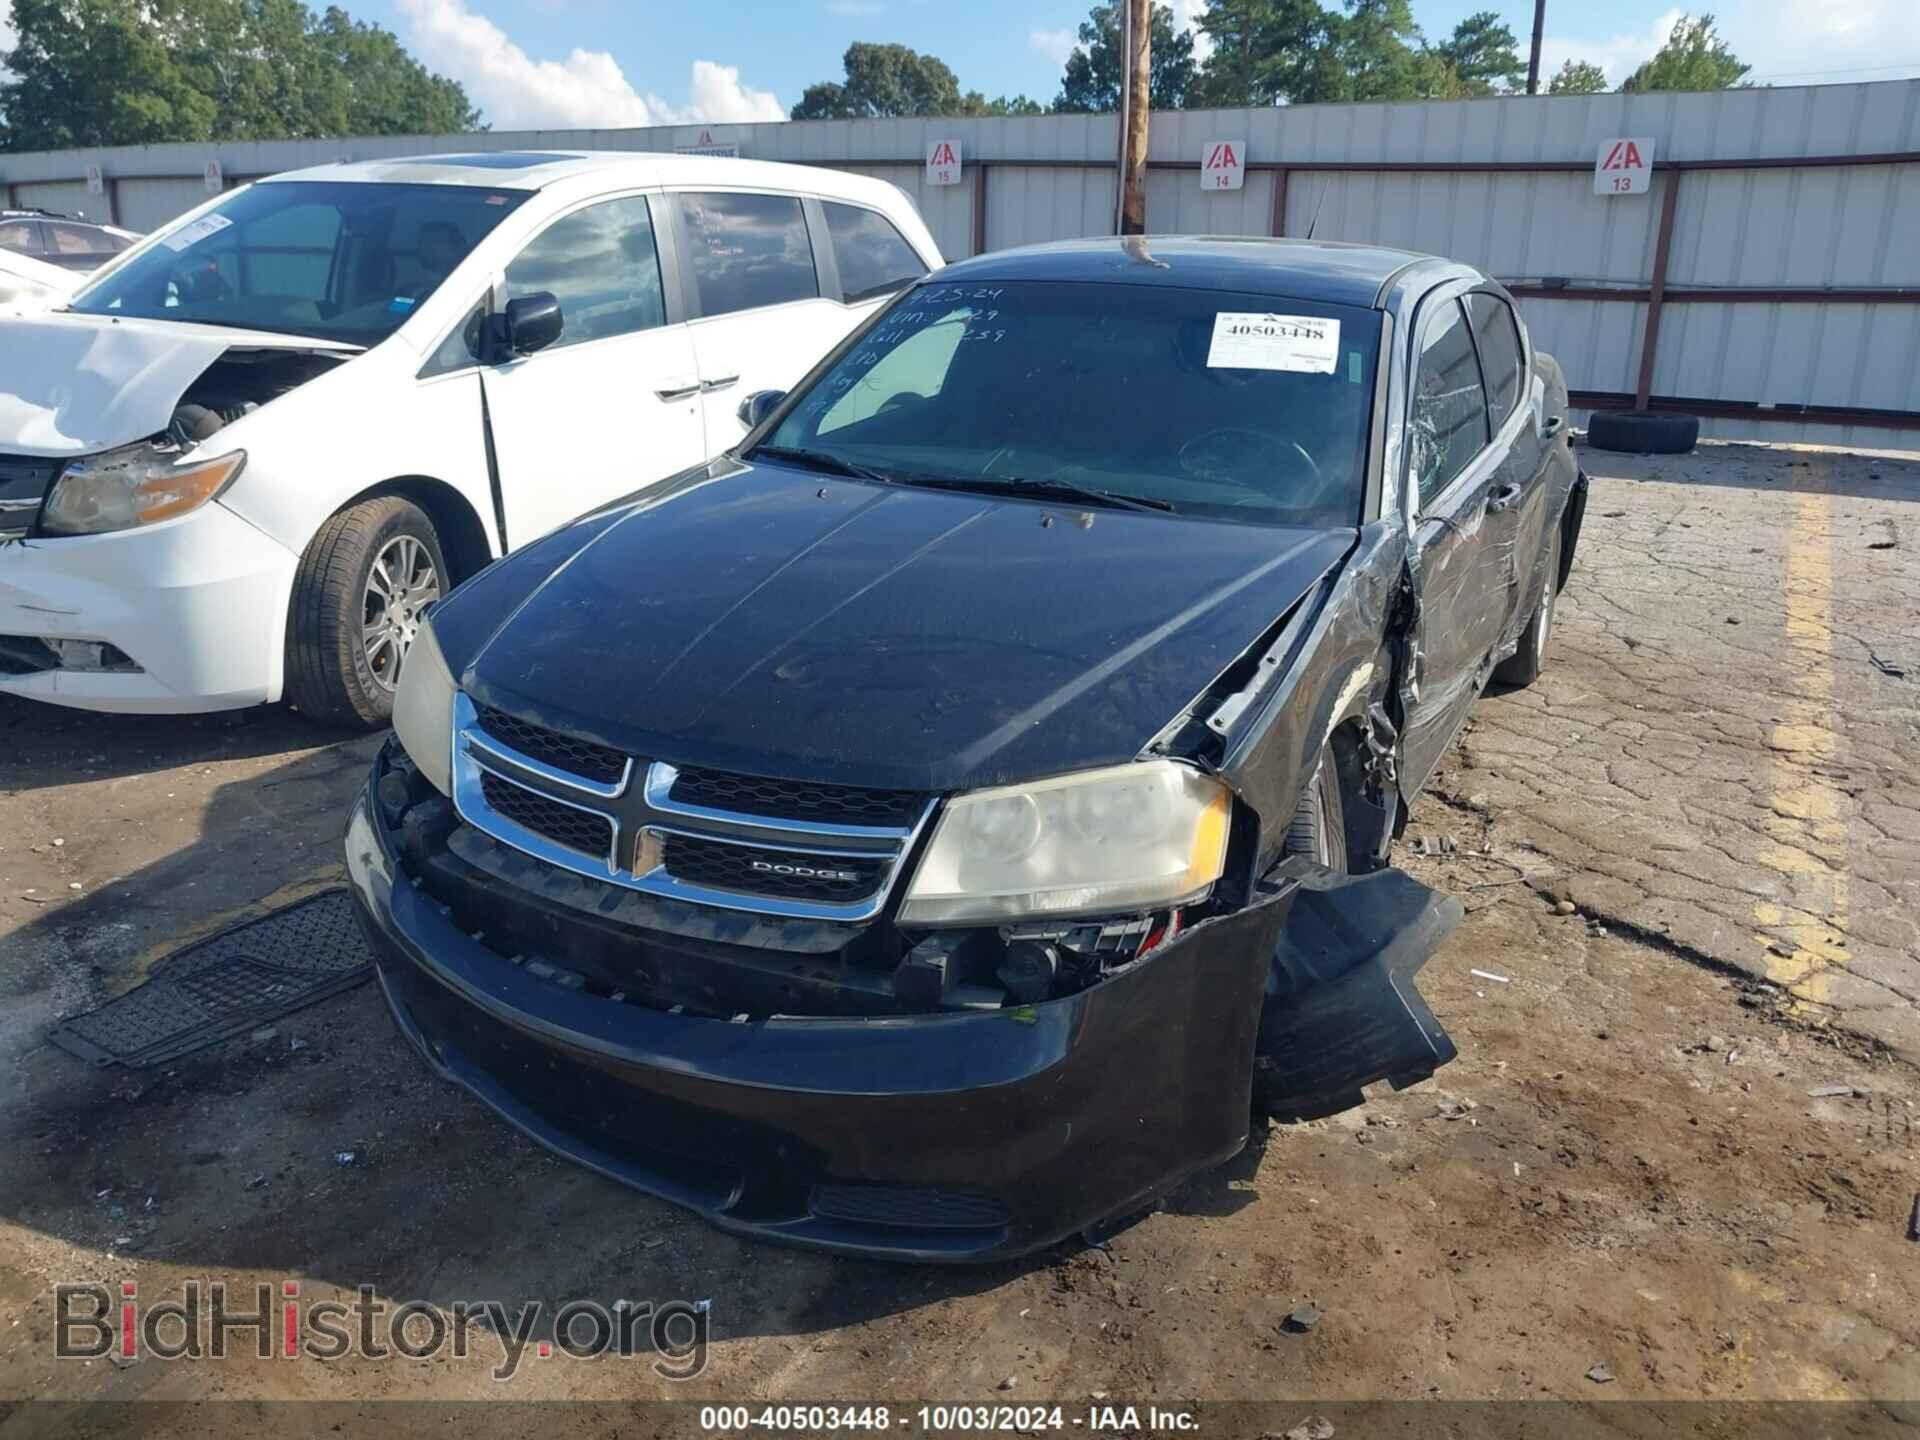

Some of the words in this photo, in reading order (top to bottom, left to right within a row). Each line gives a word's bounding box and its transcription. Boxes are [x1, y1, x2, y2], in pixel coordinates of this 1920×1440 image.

[1215, 175, 1230, 188] 14
[1613, 177, 1632, 192] 13
[1225, 323, 1325, 341] 40503448
[752, 861, 857, 881] DODGE
